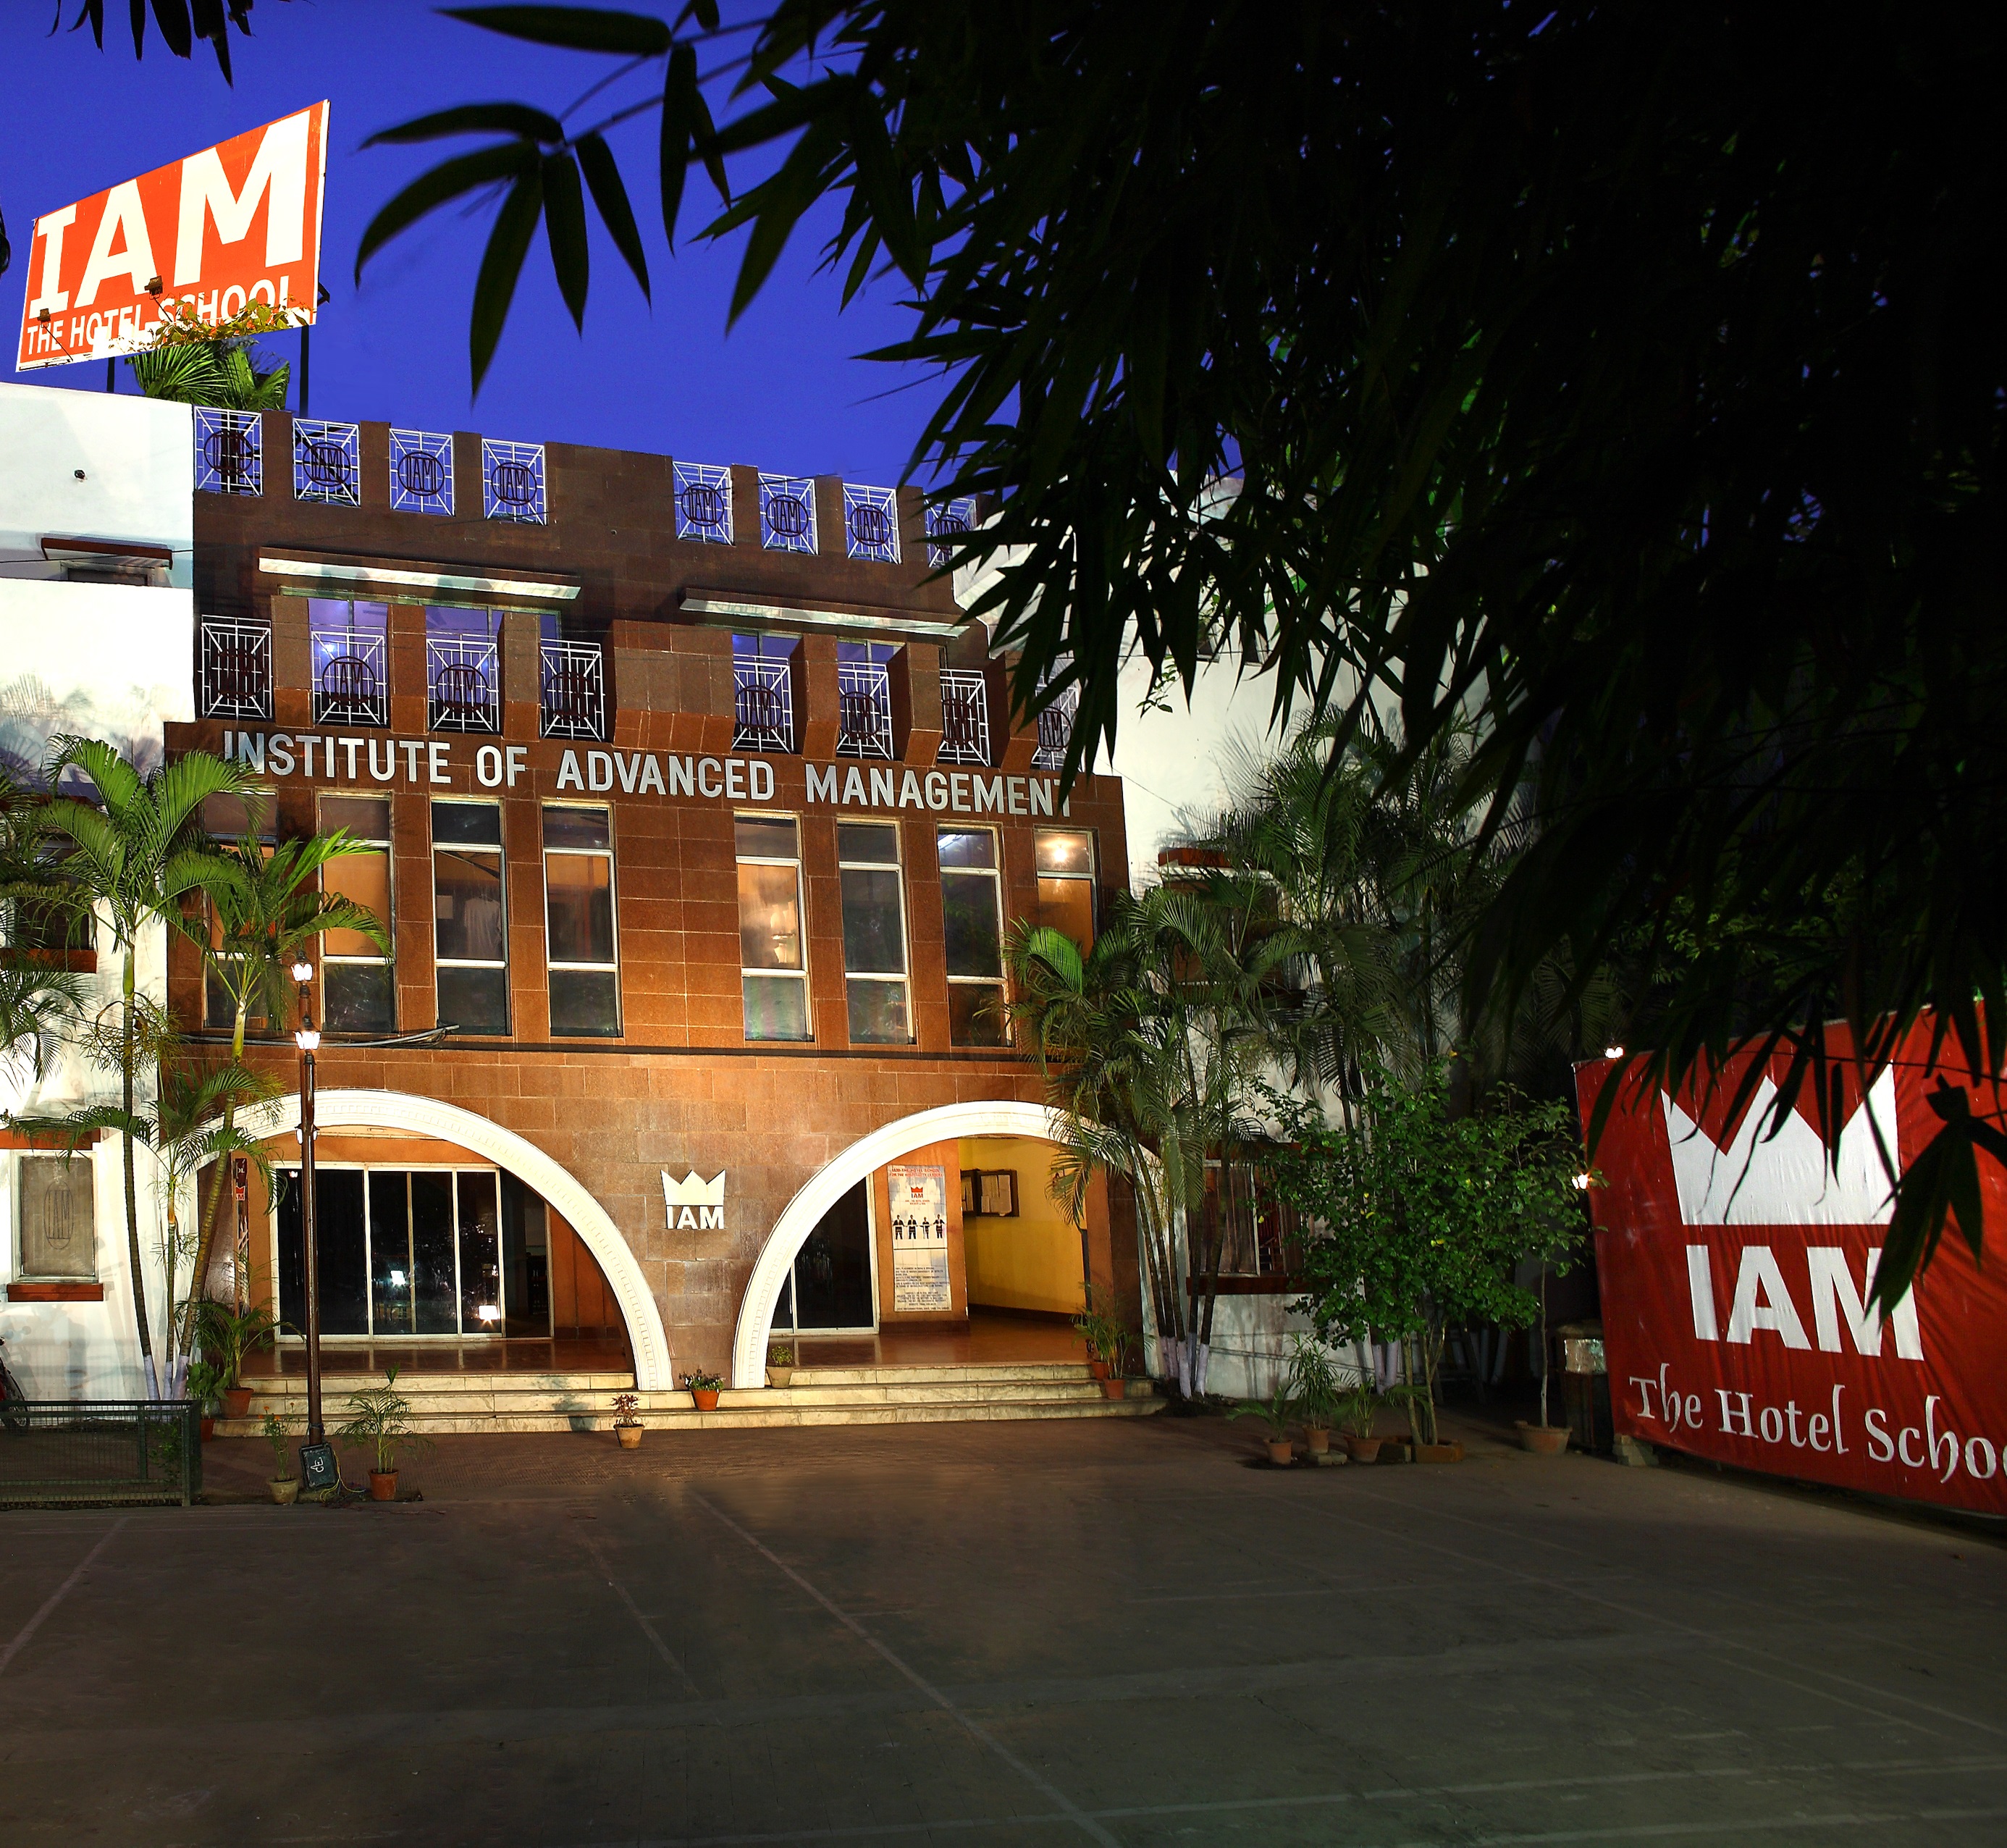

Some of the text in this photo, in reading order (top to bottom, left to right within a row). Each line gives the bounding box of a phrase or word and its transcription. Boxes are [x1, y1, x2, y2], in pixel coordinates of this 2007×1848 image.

[29, 110, 311, 319] IAM
[27, 320, 64, 355] THE
[70, 304, 145, 348] HOTEL
[224, 731, 1076, 818] INSTITUTE OF ADVANCED MANAGEMENT
[666, 1205, 724, 1230] IAM
[1686, 1244, 1924, 1361] IAM
[1629, 1363, 2007, 1484] The Hotel Scho
